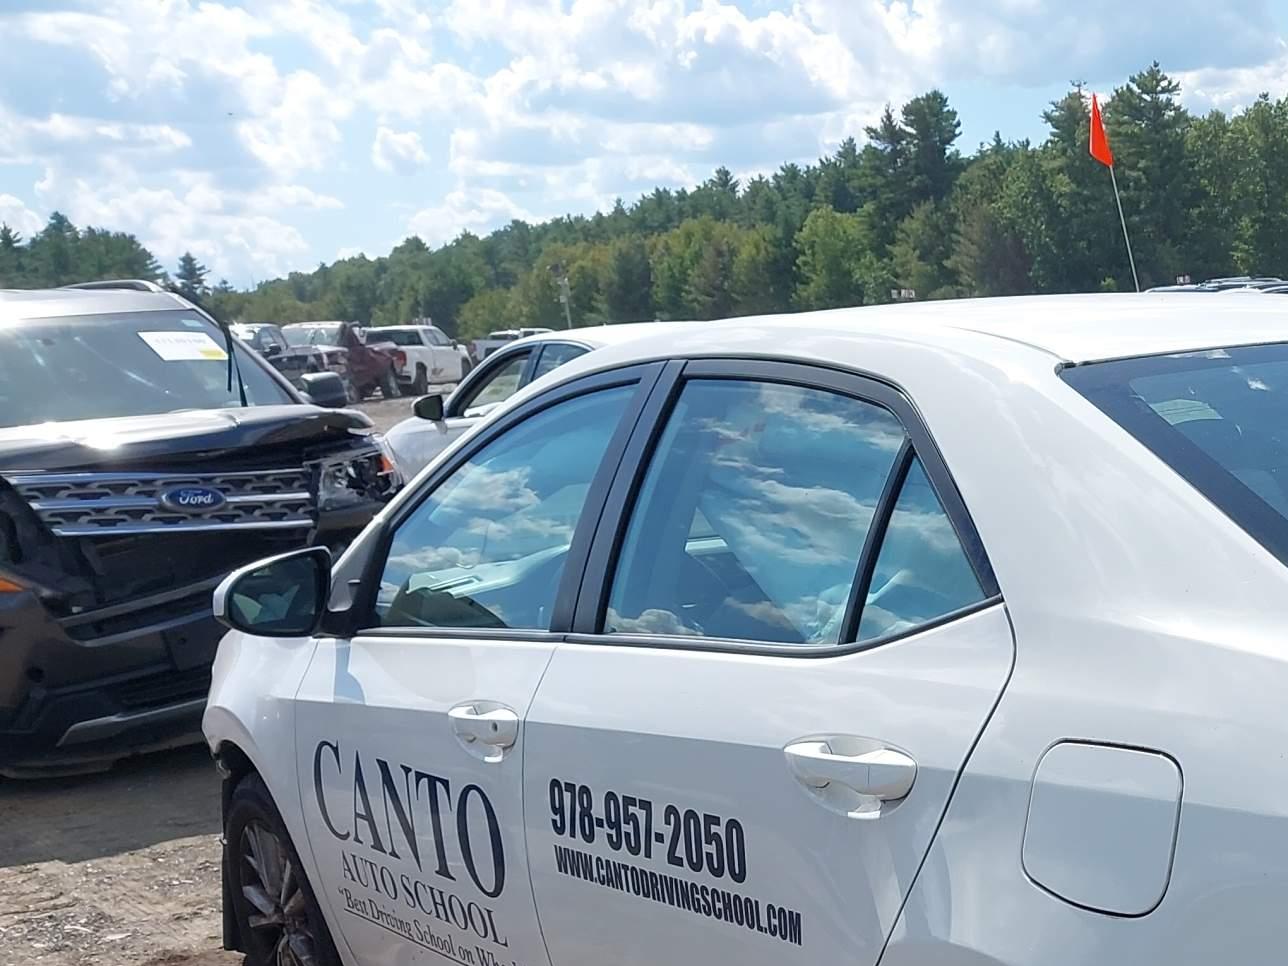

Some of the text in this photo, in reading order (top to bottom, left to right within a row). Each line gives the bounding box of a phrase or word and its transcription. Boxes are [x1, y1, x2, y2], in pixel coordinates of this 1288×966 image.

[178, 489, 214, 505] Ford
[313, 740, 506, 898] CANTO
[549, 778, 747, 883] 978-957-2050
[341, 850, 509, 947] AUTO SCHOOL
[368, 898, 415, 938] Driving
[413, 919, 456, 956] School
[458, 943, 476, 963] on
[553, 844, 803, 946] WWW.CANTODRIVINGSCHOOL.COM
